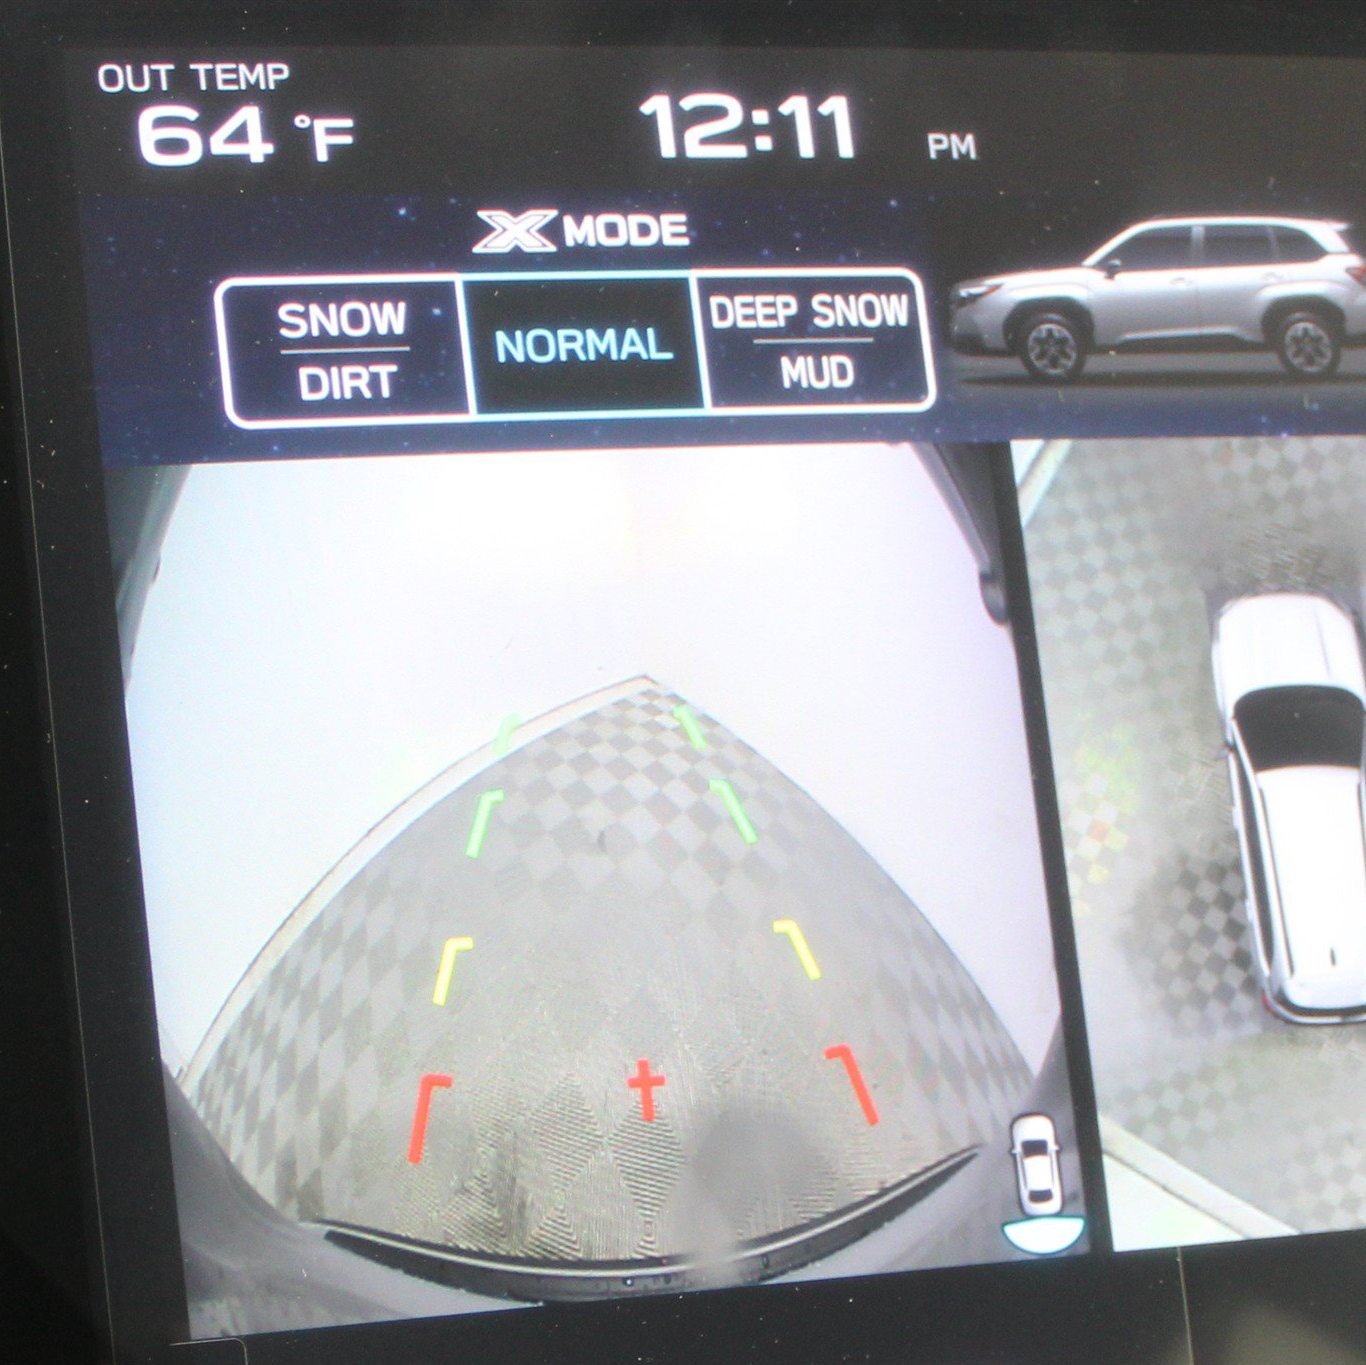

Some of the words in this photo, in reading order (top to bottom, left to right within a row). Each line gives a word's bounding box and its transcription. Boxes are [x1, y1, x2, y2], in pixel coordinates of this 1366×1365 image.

[96, 63, 175, 94] OUT
[189, 62, 291, 92] TEMP
[137, 104, 275, 167] 64
[639, 93, 856, 160] 12:11
[927, 132, 978, 161] PM
[277, 301, 407, 339] SNOW
[709, 294, 799, 329] DEEP
[811, 293, 910, 328] SNOW
[495, 325, 675, 363] NORMAL
[298, 364, 399, 402] DIRT
[781, 354, 855, 390] MUD
